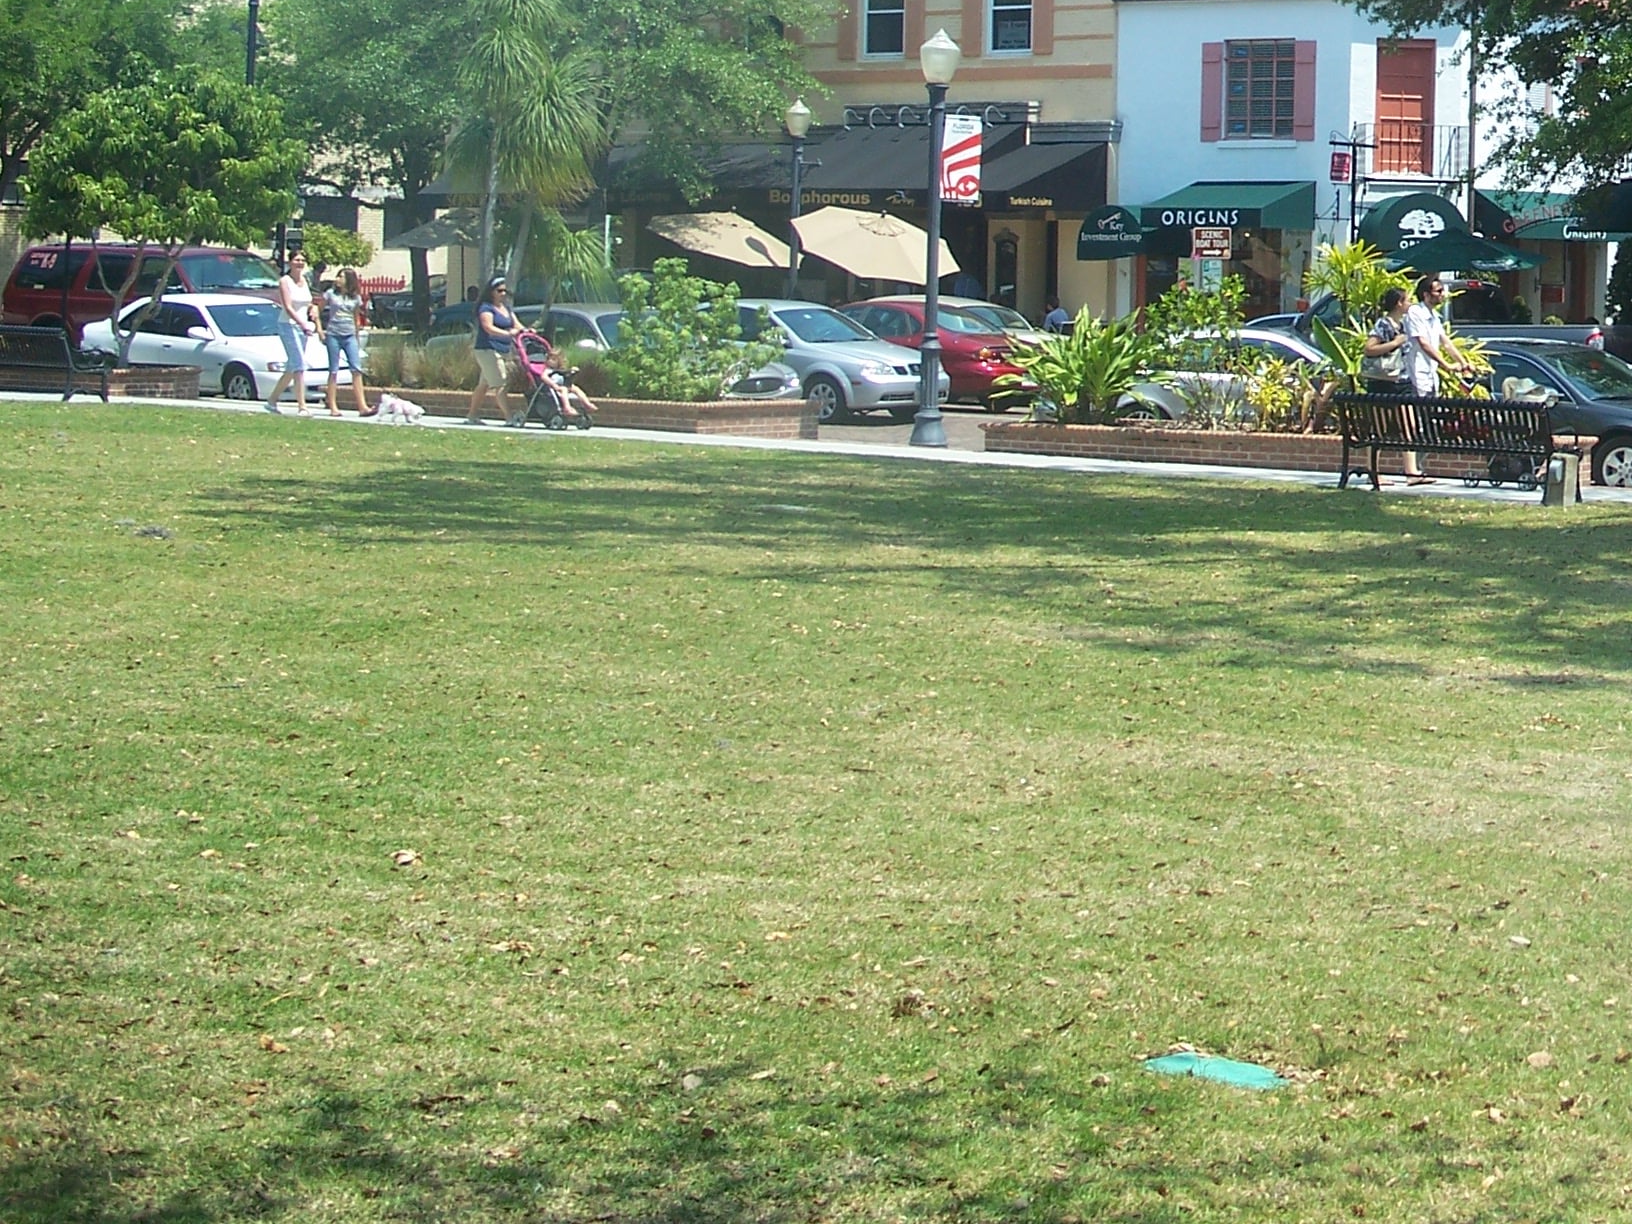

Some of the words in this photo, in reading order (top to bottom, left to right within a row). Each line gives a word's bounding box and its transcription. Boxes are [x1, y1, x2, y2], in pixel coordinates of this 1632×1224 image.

[768, 189, 871, 206] Bophorous
[1161, 210, 1239, 225] ORIGINS
[1119, 232, 1142, 243] Group
